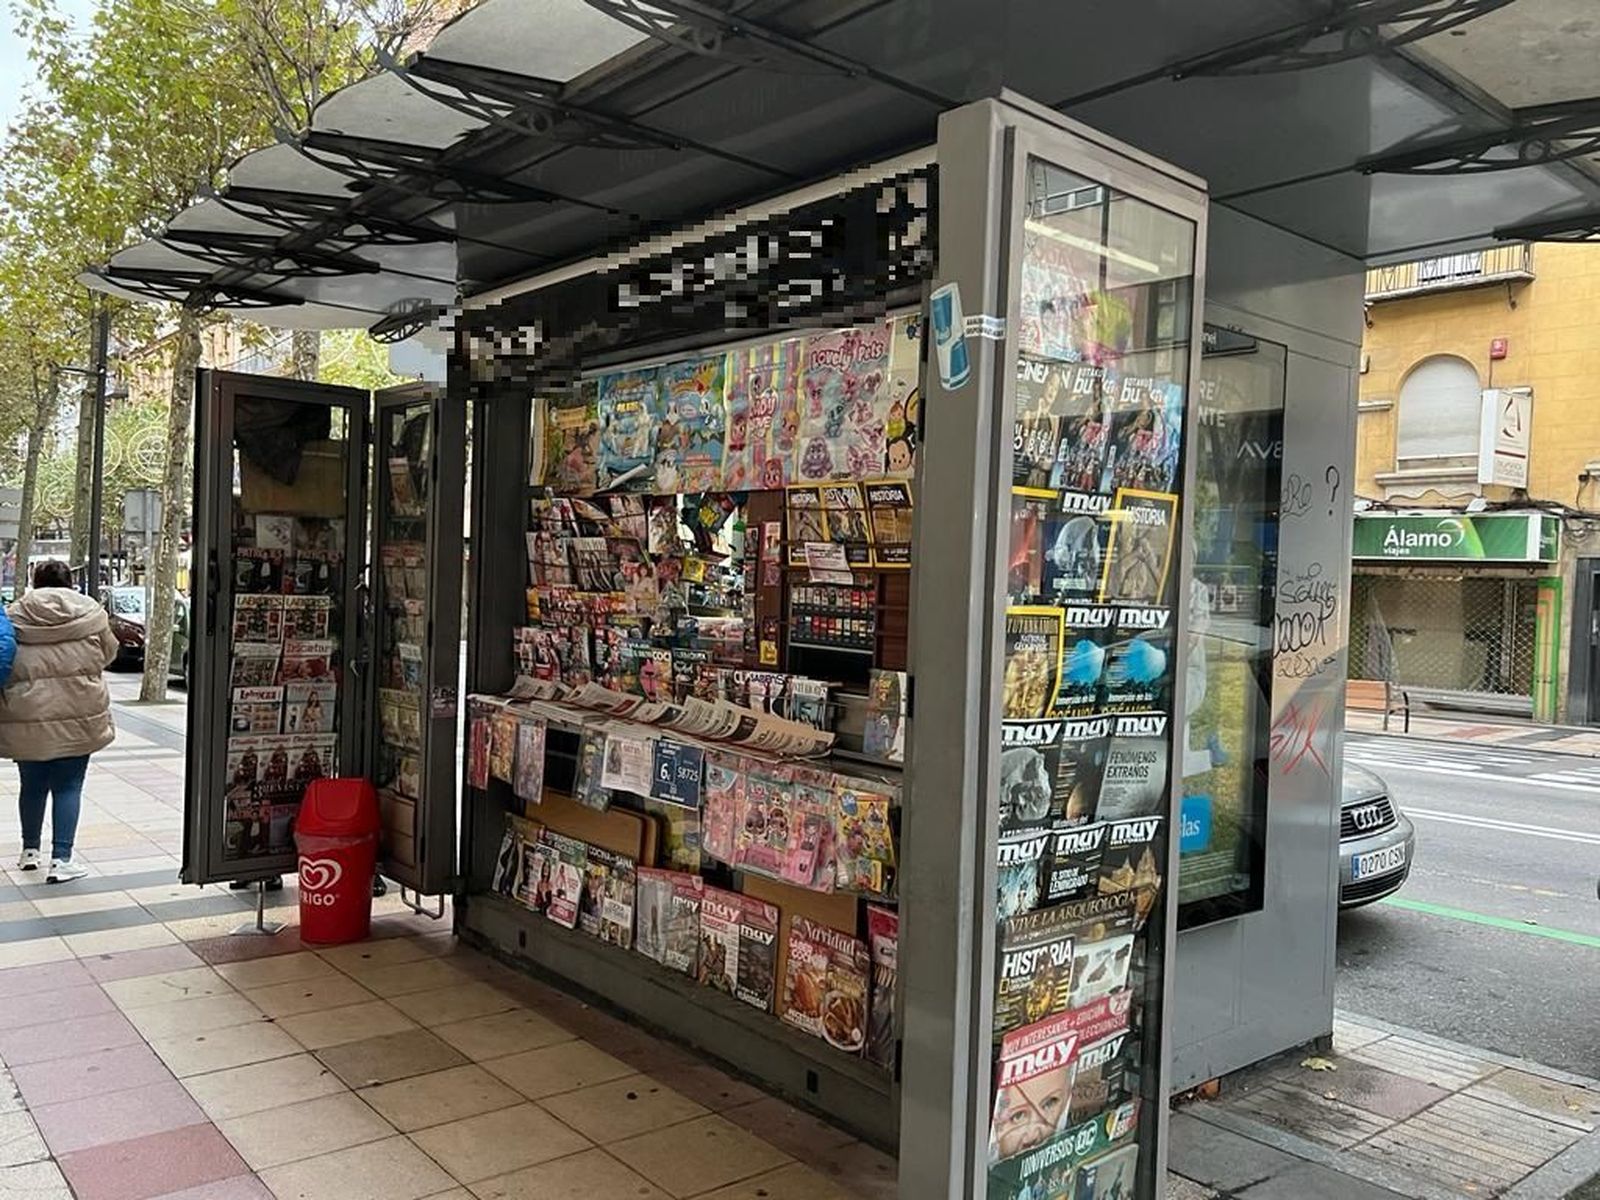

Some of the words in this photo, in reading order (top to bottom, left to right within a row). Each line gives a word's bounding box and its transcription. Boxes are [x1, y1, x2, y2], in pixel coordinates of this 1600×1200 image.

[1062, 492, 1112, 514] muy
[1384, 525, 1452, 547] Álamo
[1383, 547, 1410, 557] viajes
[1066, 607, 1113, 630] muy
[1118, 609, 1170, 632] muy
[1063, 719, 1110, 739] muy
[1116, 717, 1167, 737] muy
[1057, 826, 1105, 849] muy
[1112, 820, 1159, 841] muy
[998, 836, 1049, 861] muy
[1361, 851, 1386, 875] 0270
[702, 898, 739, 922] muy
[1041, 911, 1056, 926] LA
[741, 924, 774, 946] muy
[804, 919, 855, 956] Navidad
[1001, 1035, 1078, 1084] muy
[1078, 1036, 1125, 1068] muy
